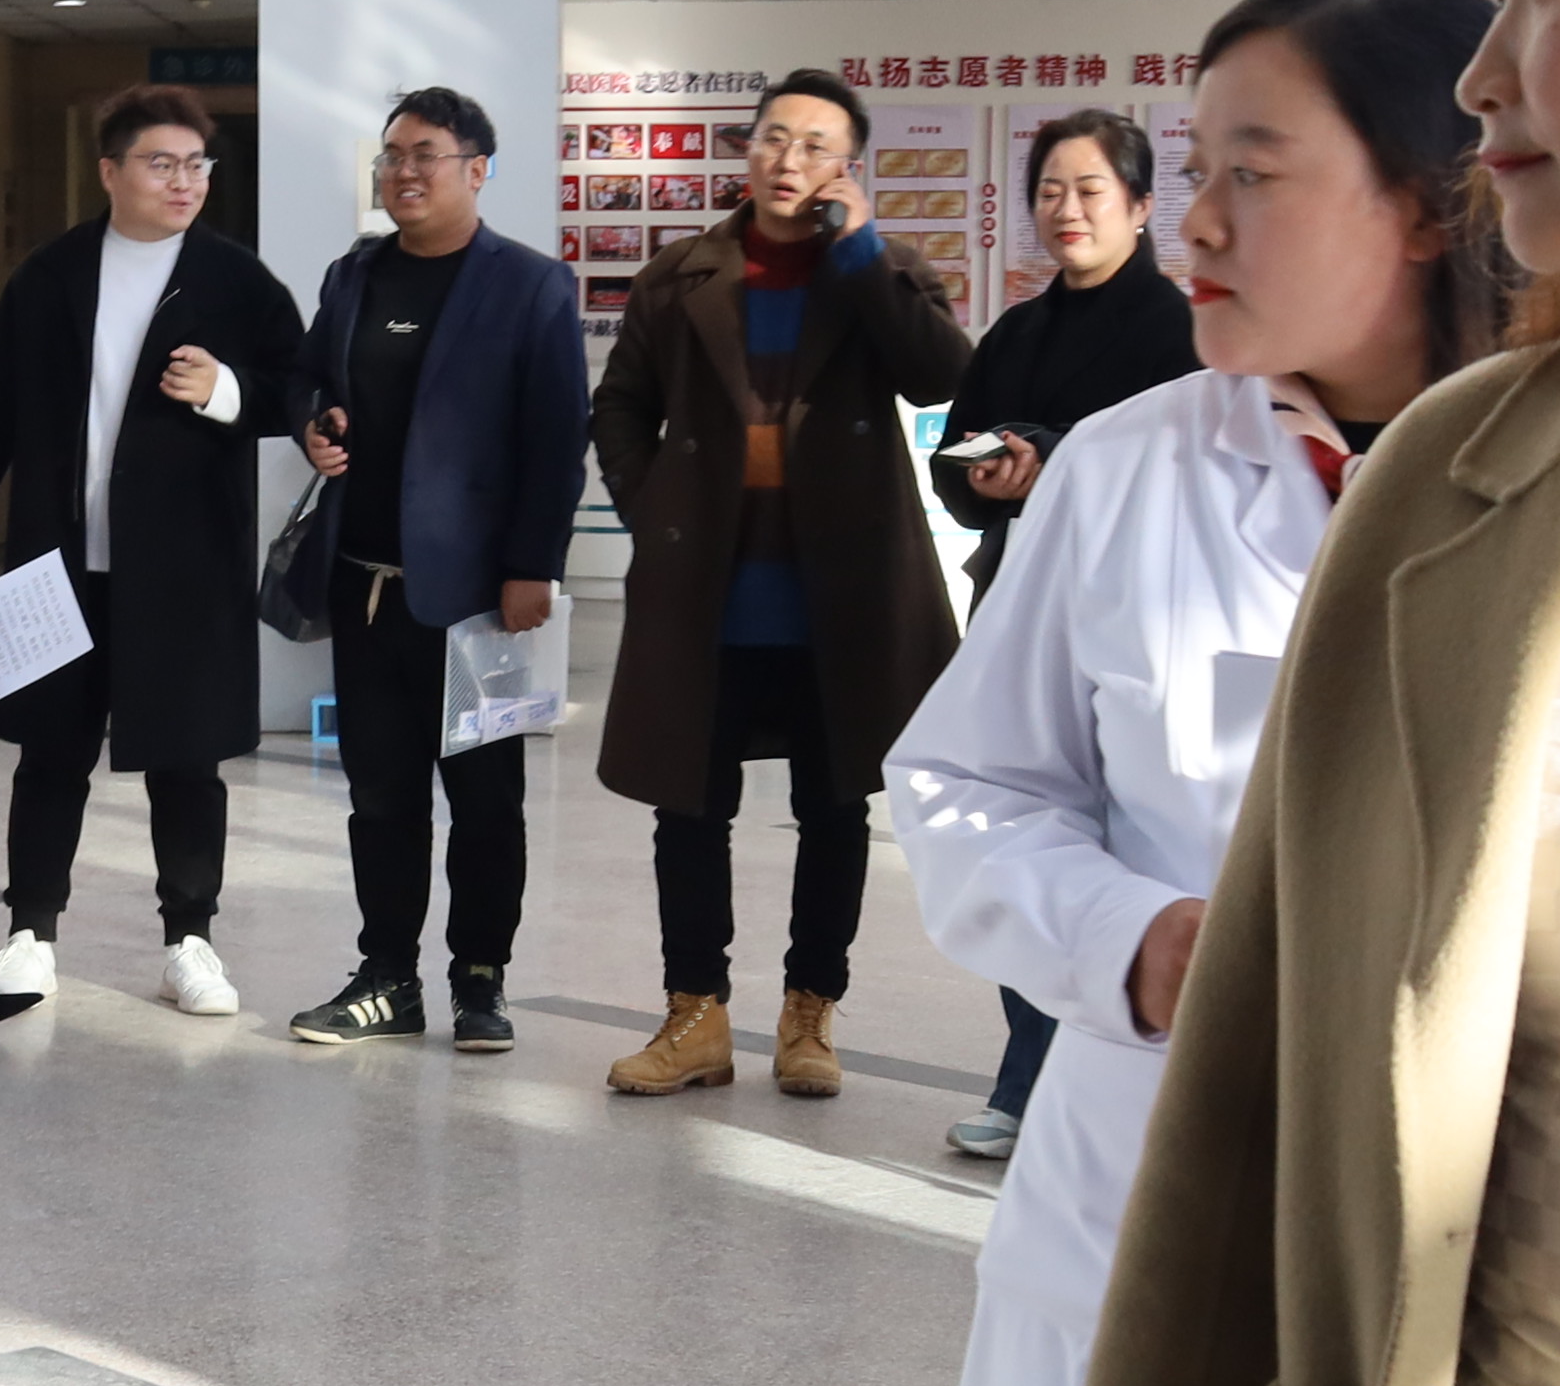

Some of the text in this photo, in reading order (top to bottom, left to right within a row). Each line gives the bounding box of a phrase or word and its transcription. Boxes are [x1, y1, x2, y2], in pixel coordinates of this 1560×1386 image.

[843, 54, 1108, 88] 弘扬志愿者精神
[652, 129, 703, 153] 奉献
